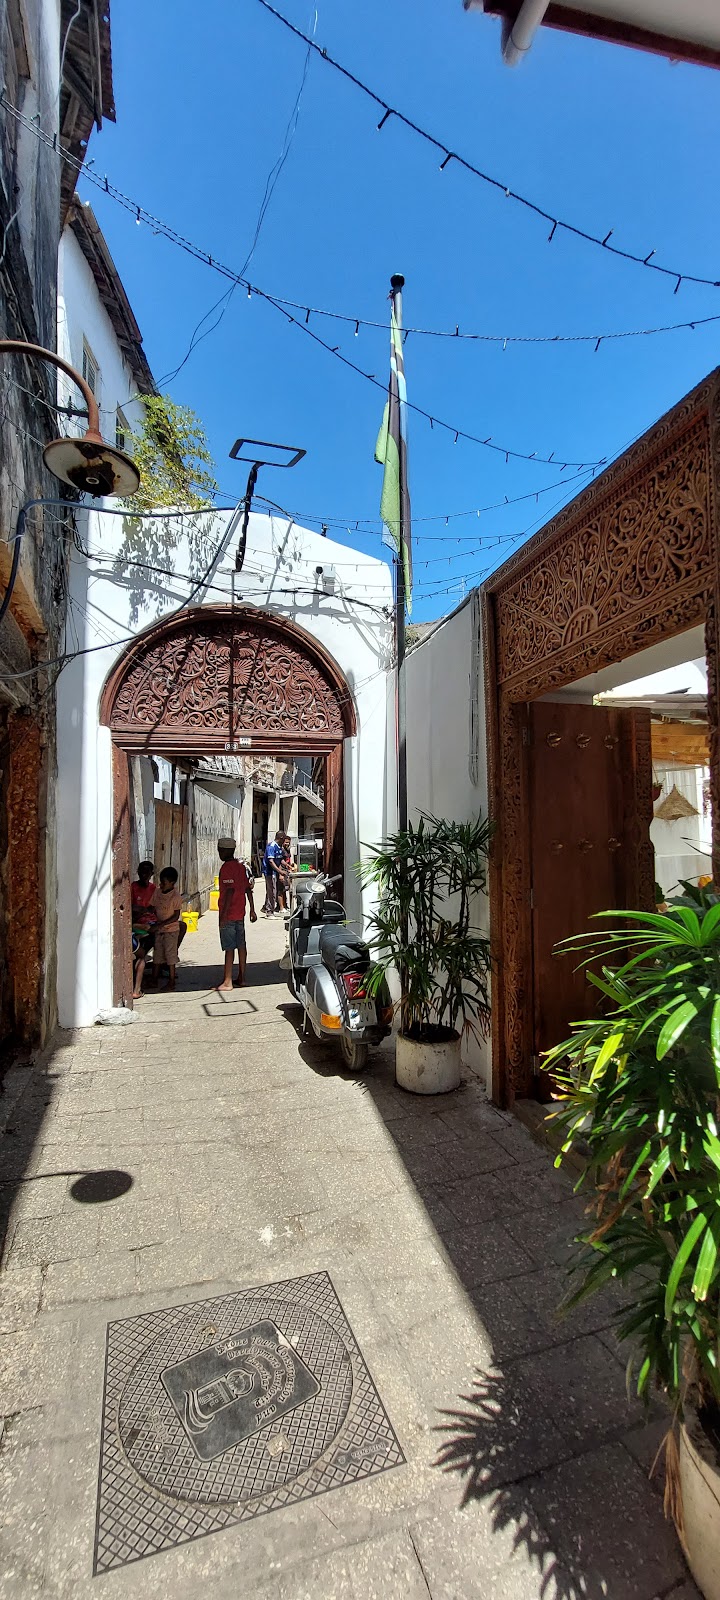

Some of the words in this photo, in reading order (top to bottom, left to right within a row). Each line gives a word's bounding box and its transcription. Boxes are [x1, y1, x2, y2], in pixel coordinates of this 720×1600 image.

[215, 1338, 248, 1355] Stone
[250, 1334, 277, 1350] Town
[275, 1344, 296, 1403] Conservation
[252, 1369, 285, 1408] Authority
[255, 1404, 277, 1426] and
